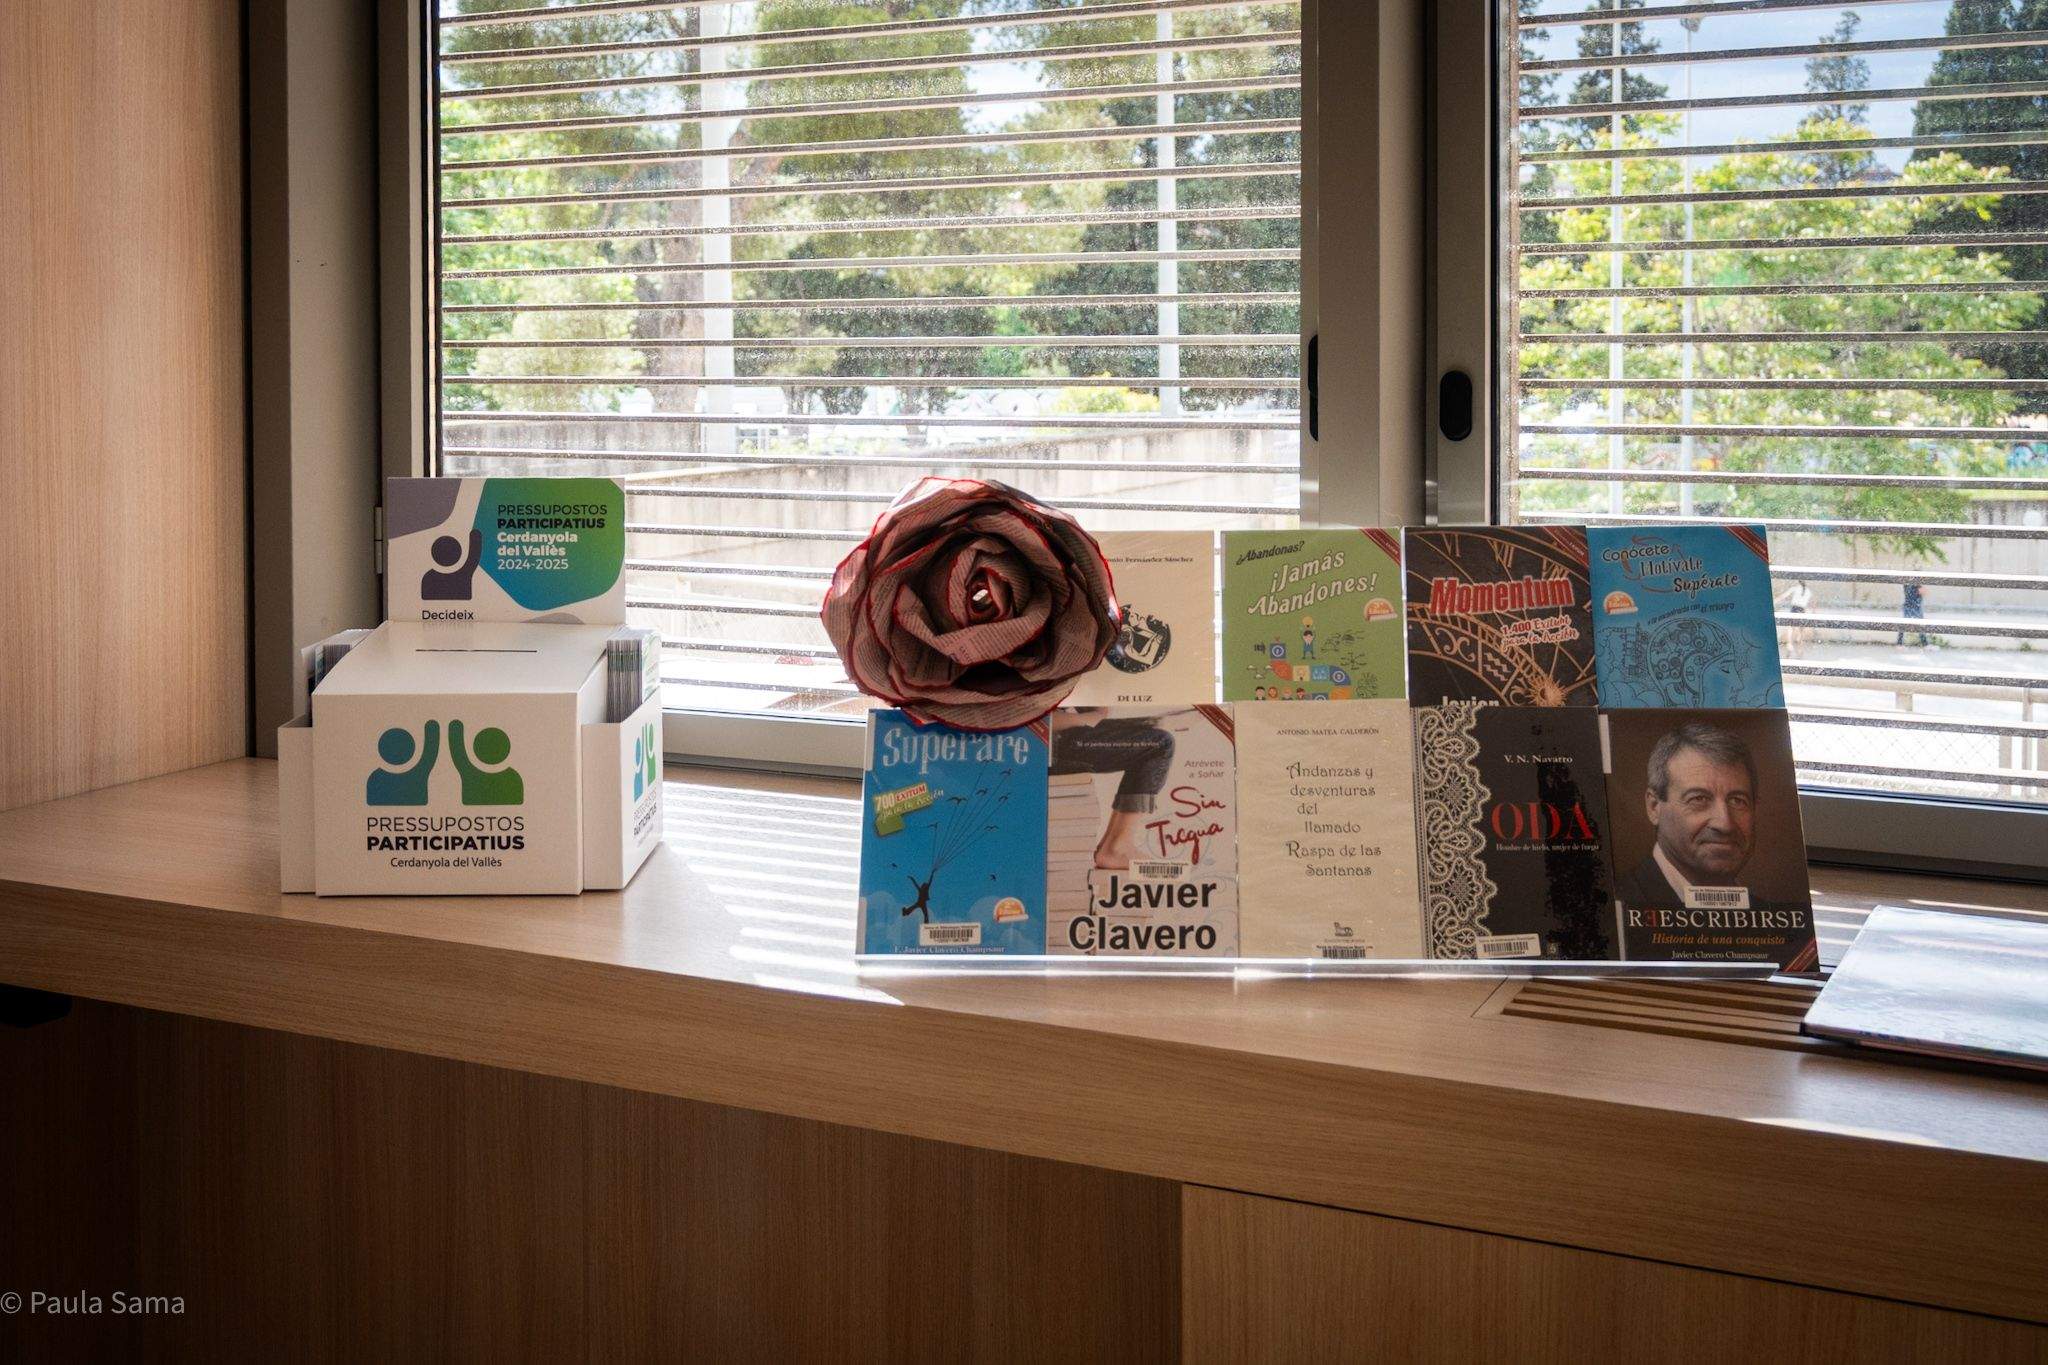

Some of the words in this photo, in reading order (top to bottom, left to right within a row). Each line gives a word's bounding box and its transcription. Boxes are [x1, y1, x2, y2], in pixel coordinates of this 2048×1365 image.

[498, 504, 608, 515] PRESSUPOSTOS
[497, 518, 605, 529] PARTICIPATIUS
[497, 532, 578, 545] Cerdanyola
[497, 545, 520, 556] del
[523, 544, 566, 556] Vallès
[1236, 541, 1305, 566] ¿Abandonas?
[1602, 544, 1670, 562] Conócete
[498, 558, 569, 570] 2024-2025
[1270, 550, 1346, 594] ¡Jamás
[1674, 572, 1740, 599] Supérate
[1248, 575, 1378, 616] Abandones!
[1430, 575, 1575, 615] Momentum
[421, 610, 474, 620] Decideix
[1502, 620, 1532, 635] 1.400
[1184, 759, 1225, 768] Atrévete
[1504, 755, 1514, 763] V.
[1516, 755, 1530, 763] N.
[1532, 755, 1574, 763] Navarro
[1286, 761, 1361, 780] Andanzas
[1365, 767, 1374, 780] y
[1289, 784, 1377, 797] desventuras
[874, 793, 896, 813] 700
[1169, 785, 1227, 819] Sin
[1297, 803, 1318, 815] del
[366, 816, 525, 832] PRESSUPOSTOS
[1304, 820, 1361, 833] llamado
[1490, 801, 1596, 840] ODA
[366, 836, 525, 851] PARTICIPATIUS
[1145, 820, 1225, 866] Tregua
[1286, 840, 1335, 859] Raspa
[1339, 844, 1357, 857] de
[1360, 844, 1382, 857] las
[390, 857, 451, 869] Cerdanyola
[453, 857, 470, 867] del
[471, 857, 502, 867] Vallès
[1306, 863, 1372, 877] Santanas
[1098, 875, 1217, 909] Javier
[1069, 916, 1217, 950] Clavero
[1652, 933, 1695, 945] Historia
[1697, 933, 1710, 944] de
[1712, 936, 1734, 945] una
[1736, 933, 1786, 946] conquista
[1671, 951, 1694, 960] Javier
